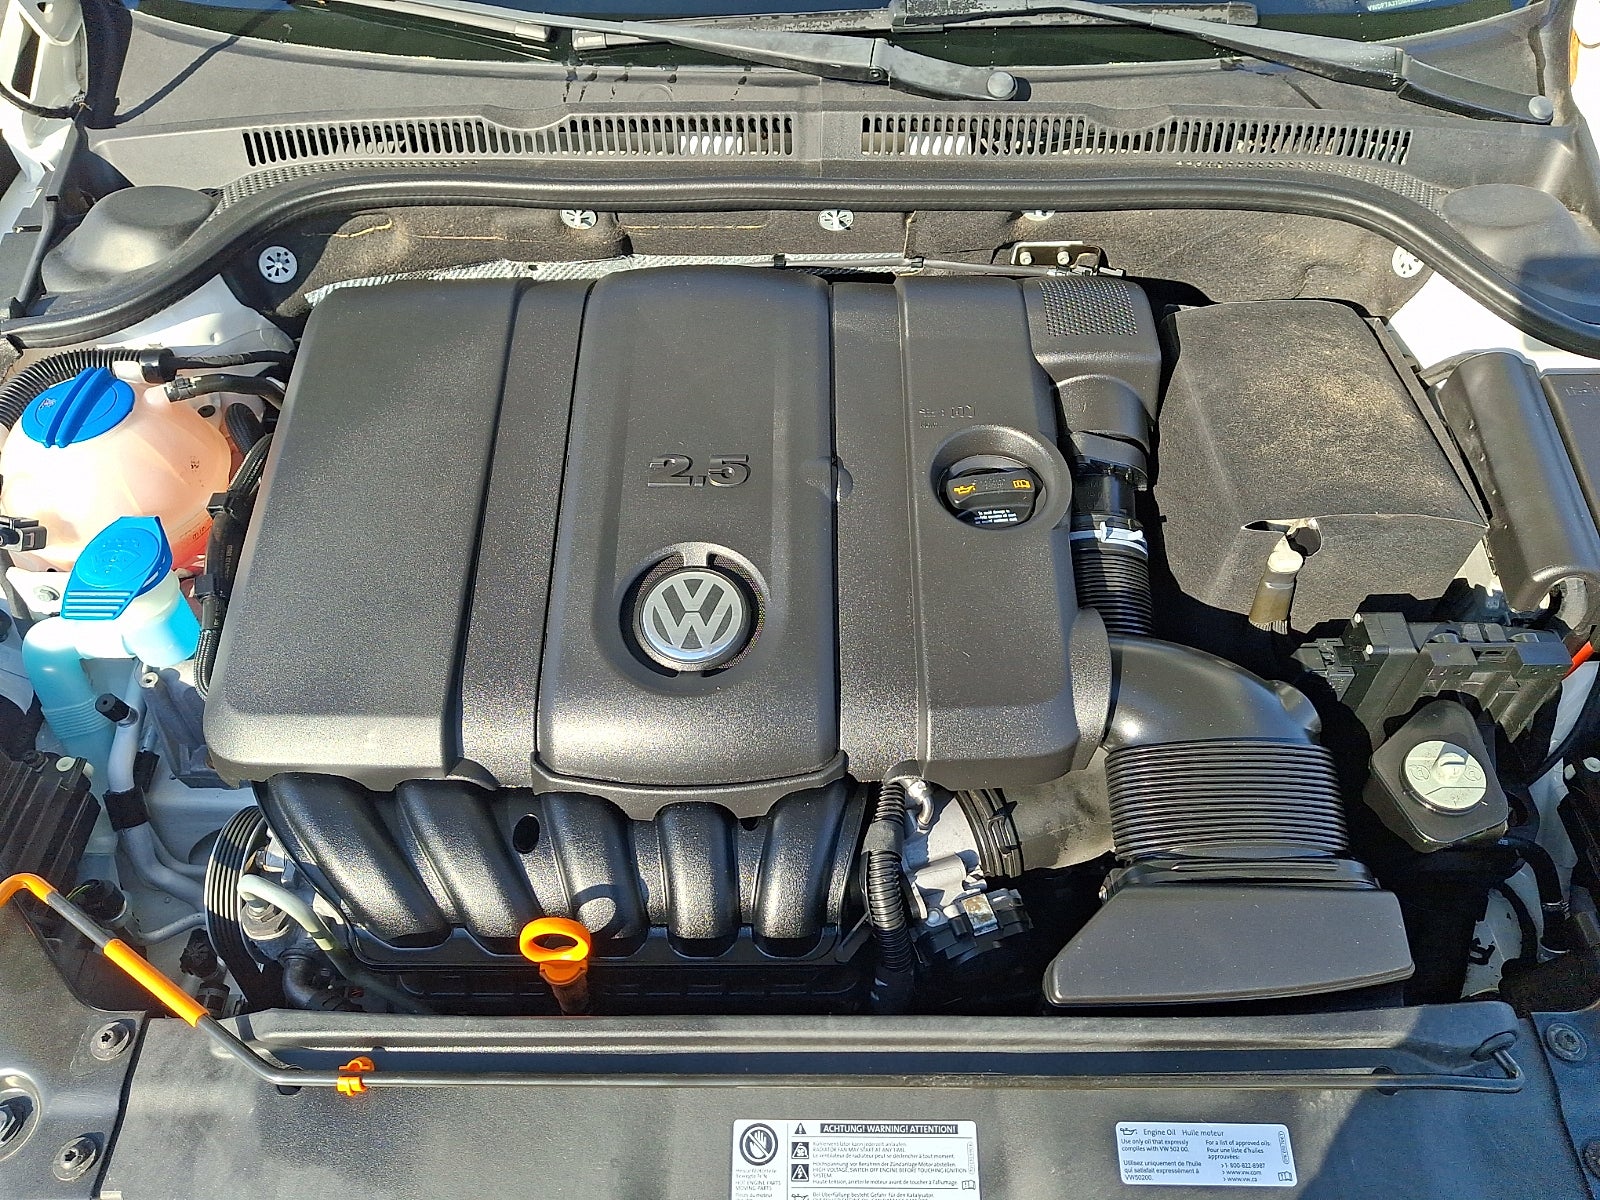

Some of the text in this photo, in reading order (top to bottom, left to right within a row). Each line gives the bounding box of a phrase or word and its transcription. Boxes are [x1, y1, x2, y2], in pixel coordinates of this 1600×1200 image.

[648, 453, 751, 487] 2.5
[823, 1124, 956, 1134] ACHTUNG! WARNING! ATTENTION!
[1143, 1129, 1165, 1137] Engine
